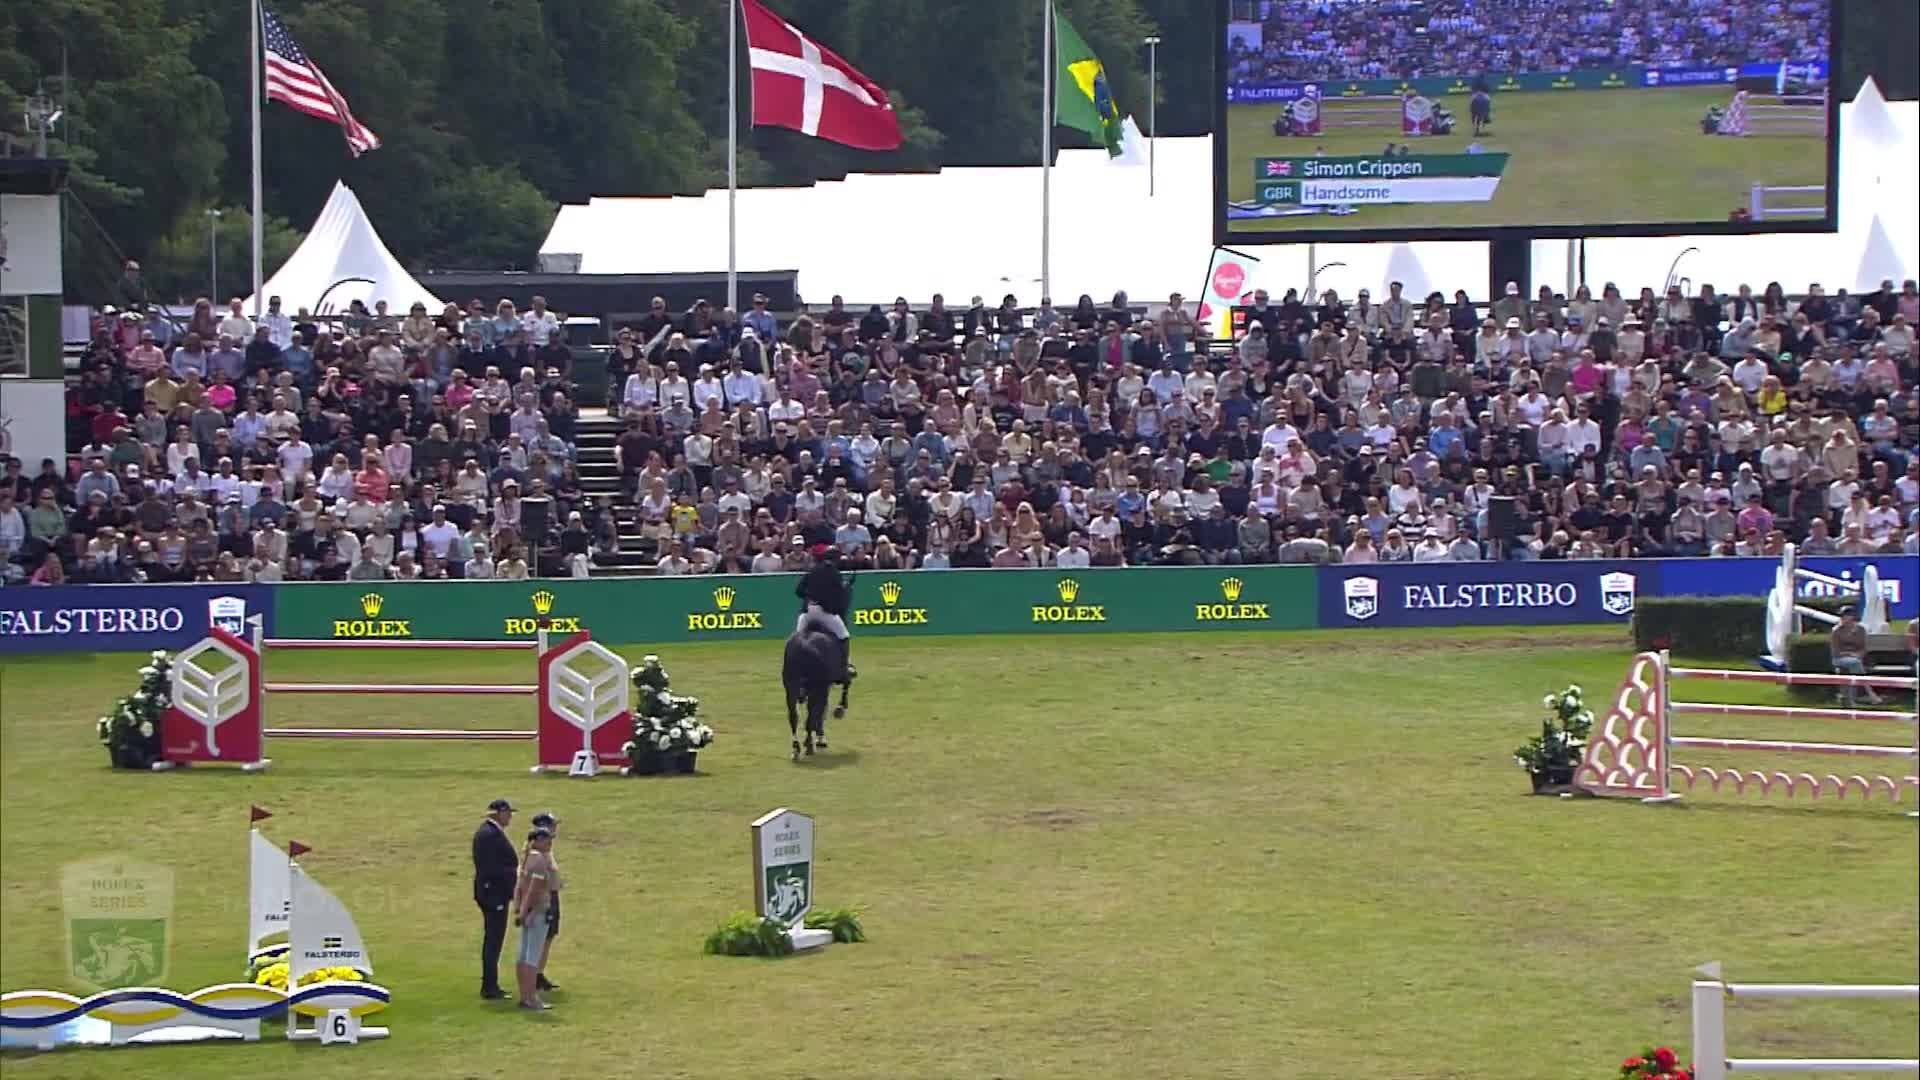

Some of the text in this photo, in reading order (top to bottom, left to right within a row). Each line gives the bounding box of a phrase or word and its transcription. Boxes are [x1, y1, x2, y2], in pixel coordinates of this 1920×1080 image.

[1303, 159, 1423, 178] Simon Crippen
[1264, 186, 1293, 200] GBR
[1304, 184, 1390, 200] Handsome
[1404, 582, 1577, 608] FALSTERBO
[854, 608, 928, 625] ROLEX
[1032, 605, 1105, 621] ROLEX
[1196, 604, 1270, 619] ROLEX
[0, 607, 184, 634] FALSTERBO
[333, 620, 411, 637] ROLEX
[504, 617, 581, 634] ROEX
[688, 612, 763, 630] ROLEX
[577, 755, 588, 771] 7
[333, 1015, 346, 1036] 6
